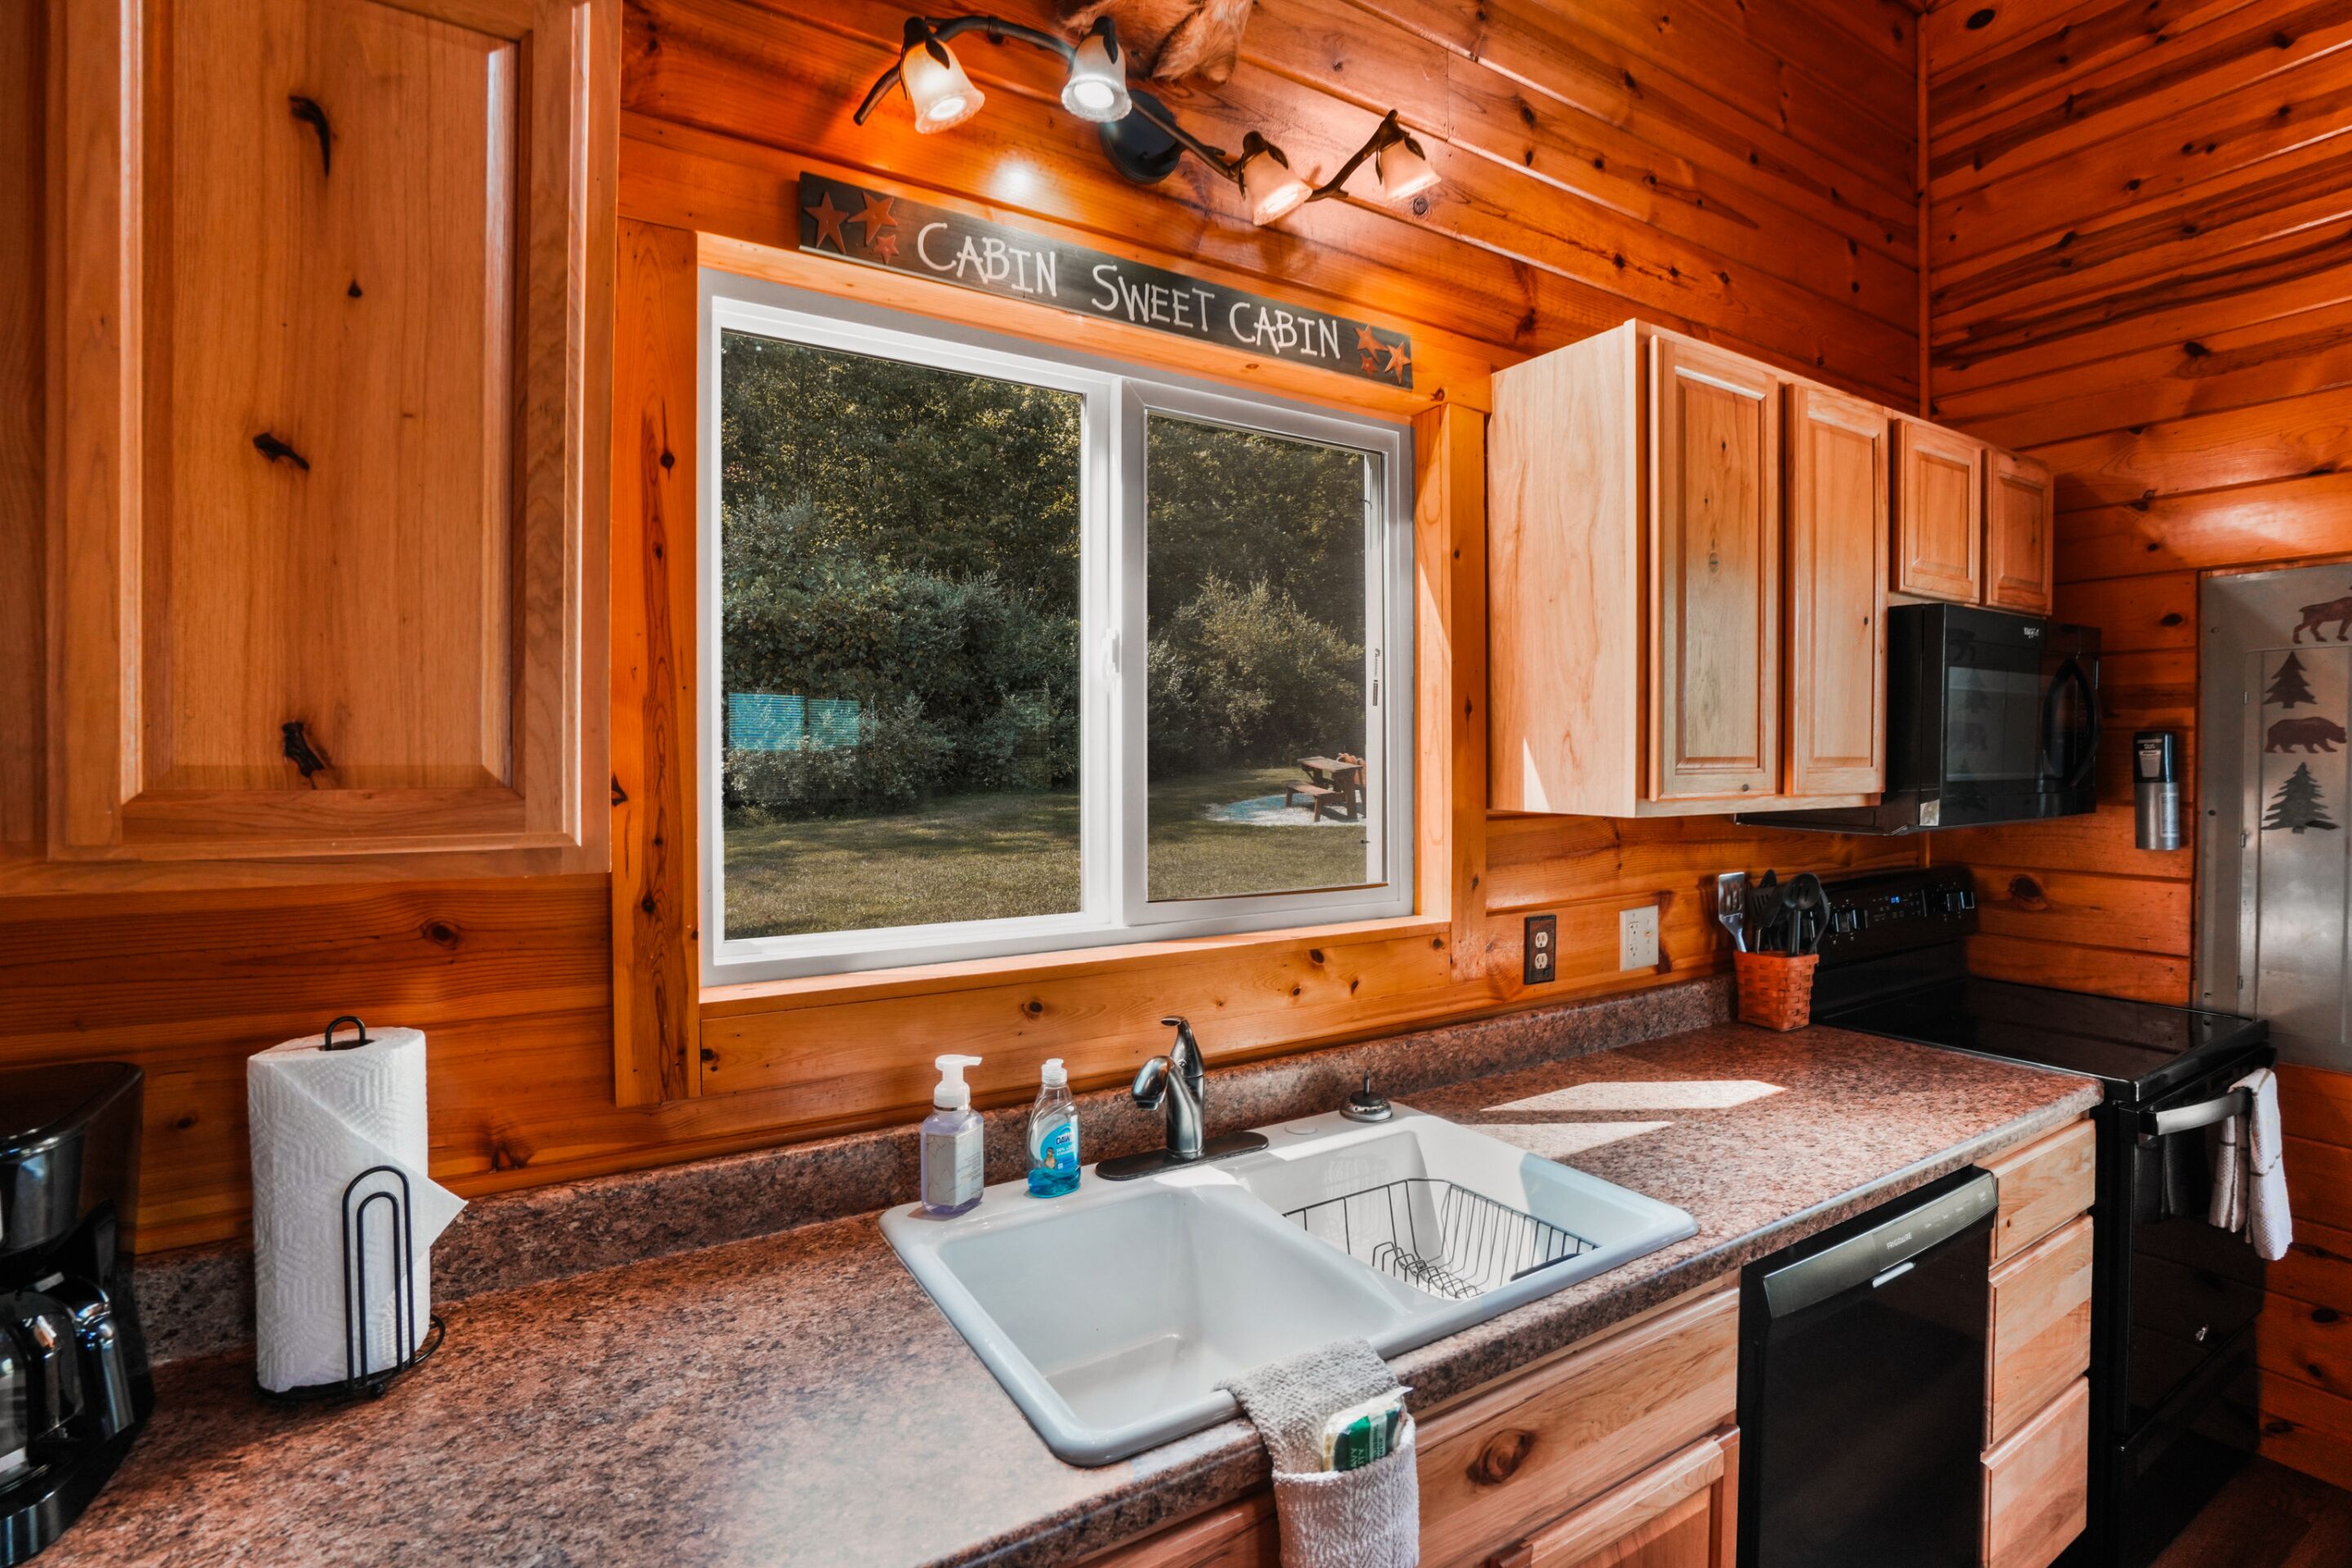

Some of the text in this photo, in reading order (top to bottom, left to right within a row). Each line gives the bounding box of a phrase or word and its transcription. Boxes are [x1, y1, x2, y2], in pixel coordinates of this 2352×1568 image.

[918, 222, 1341, 359] CABIN SWEET CABIN
[1056, 1135, 1073, 1144] DAW
